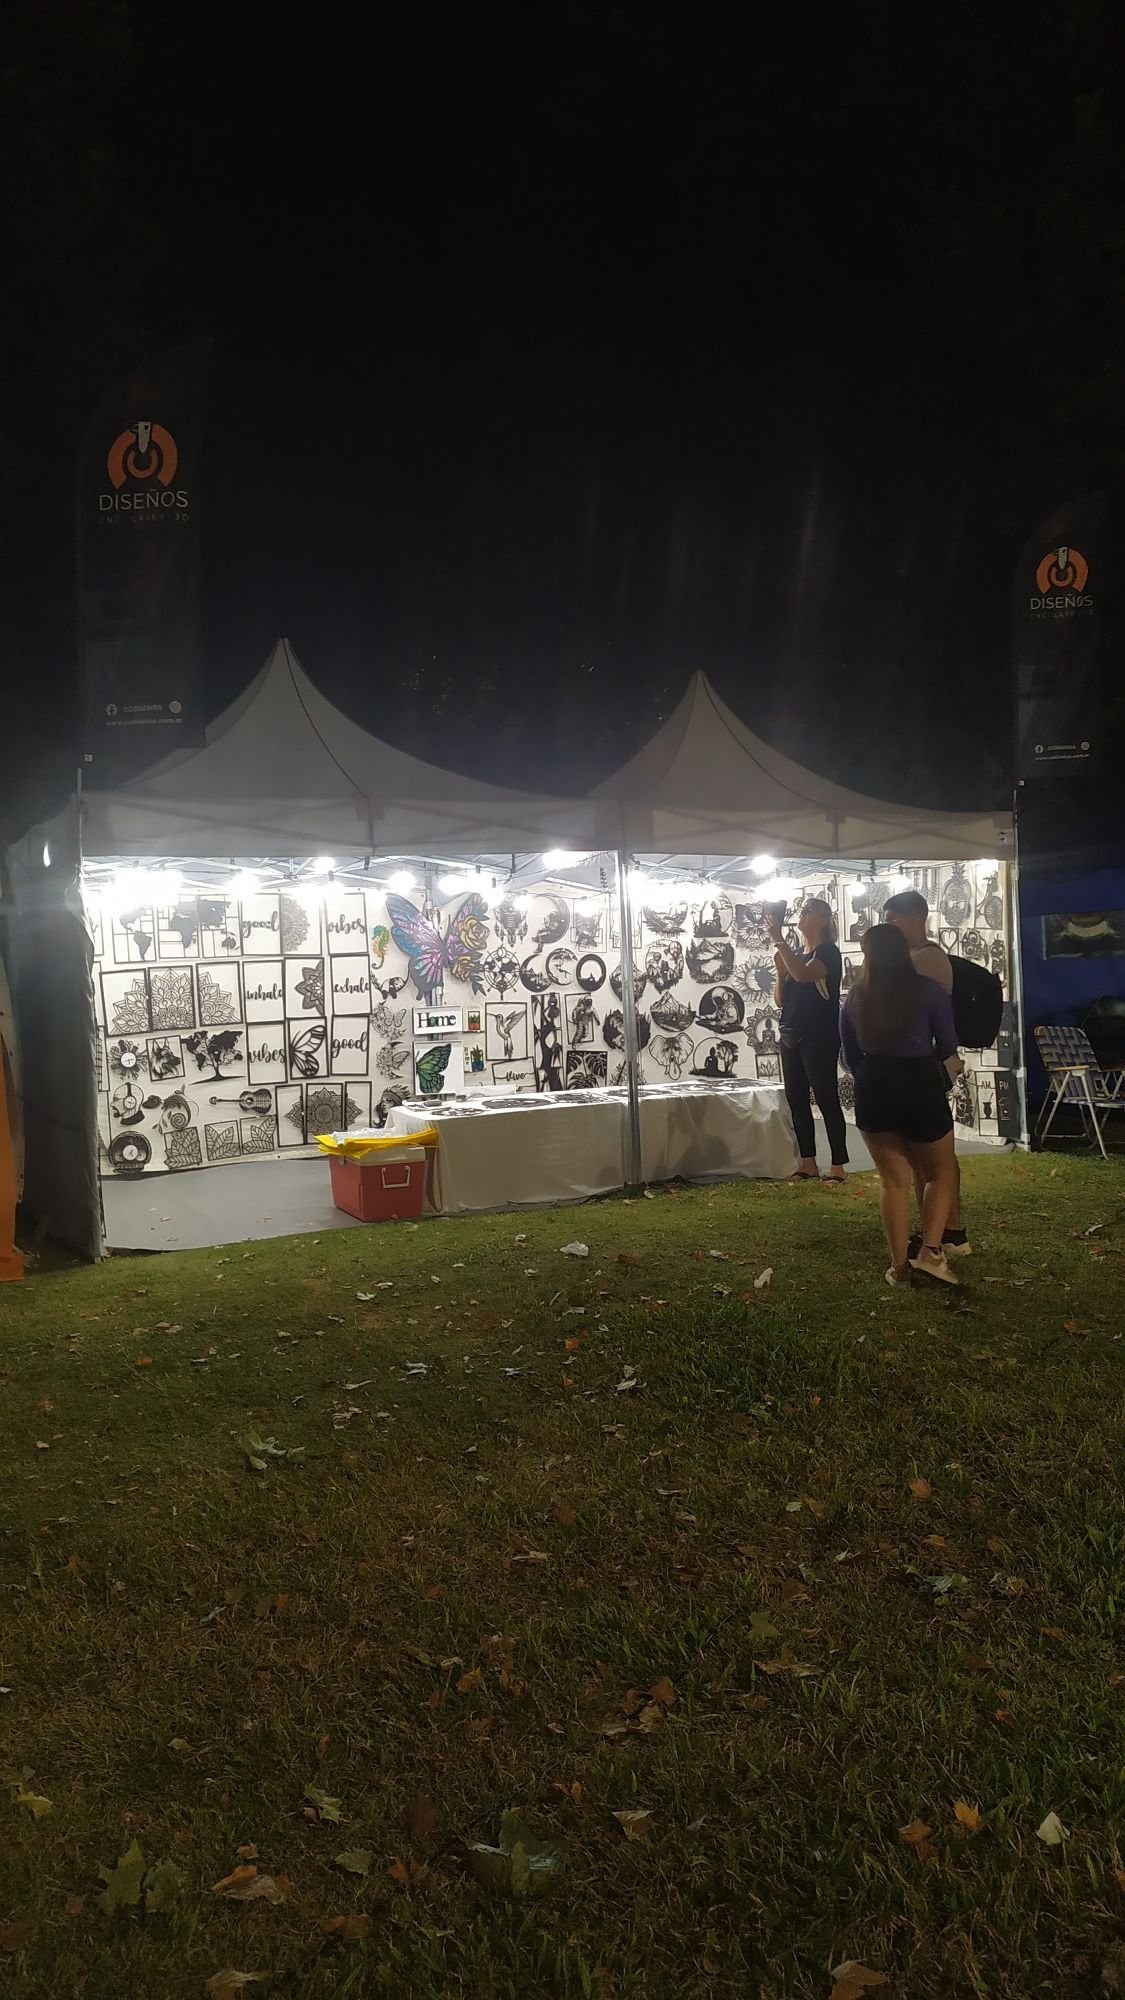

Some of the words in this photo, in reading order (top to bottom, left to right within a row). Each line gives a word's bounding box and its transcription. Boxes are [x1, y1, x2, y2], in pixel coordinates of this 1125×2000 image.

[99, 488, 189, 511] DISEÑOS
[1030, 593, 1094, 610] DISEÑOS
[241, 910, 279, 938] good
[327, 913, 366, 935] vibes
[246, 983, 283, 1000] inhale
[333, 977, 370, 994] exhale
[417, 1012, 457, 1028] Home
[248, 1042, 286, 1064] vibes
[332, 1031, 367, 1059] good
[981, 1080, 991, 1090] AM
[998, 1080, 1009, 1091] PM
